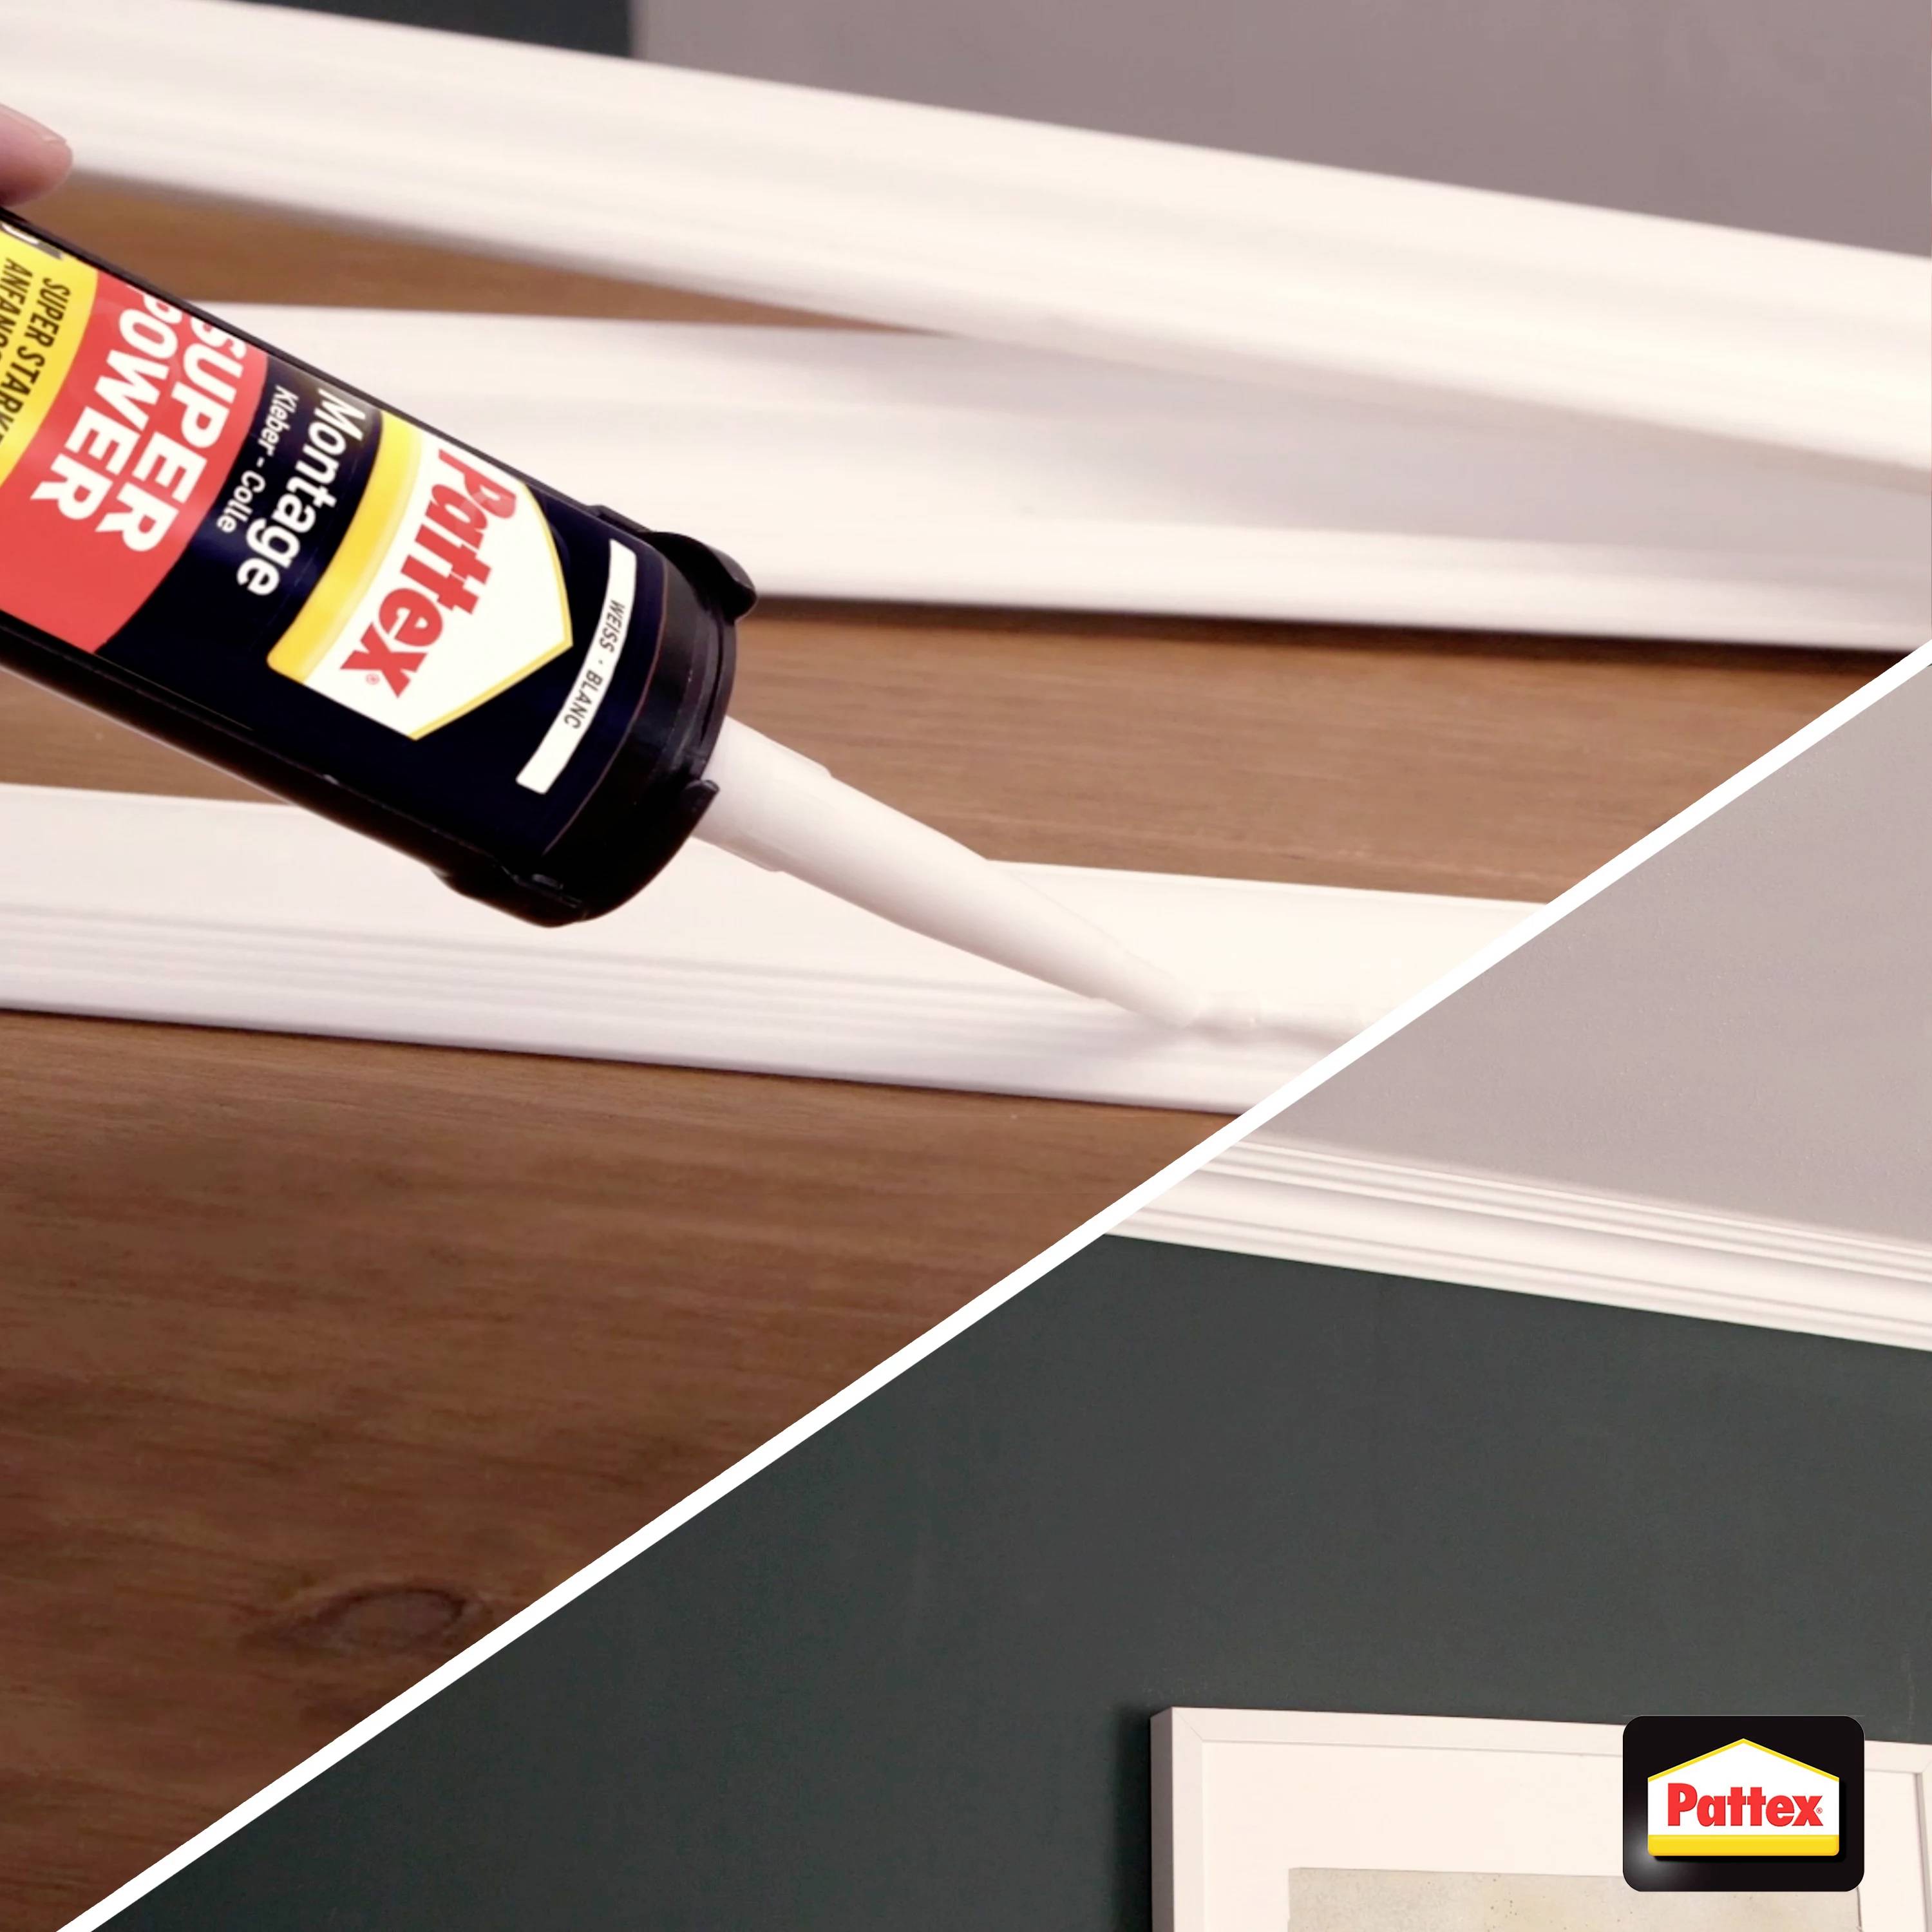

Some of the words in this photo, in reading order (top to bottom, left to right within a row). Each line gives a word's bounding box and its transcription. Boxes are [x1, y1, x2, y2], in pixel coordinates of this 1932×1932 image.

[24, 278, 71, 348] SUPER
[0, 345, 46, 443] STAR
[30, 283, 184, 520] POWER
[95, 316, 247, 552] SUPER
[257, 384, 299, 457] Kleber
[217, 469, 266, 533] Colle
[236, 388, 366, 596] Montage
[339, 448, 517, 698] Pattex
[598, 599, 625, 653] WEISS
[563, 669, 603, 729] BLANC
